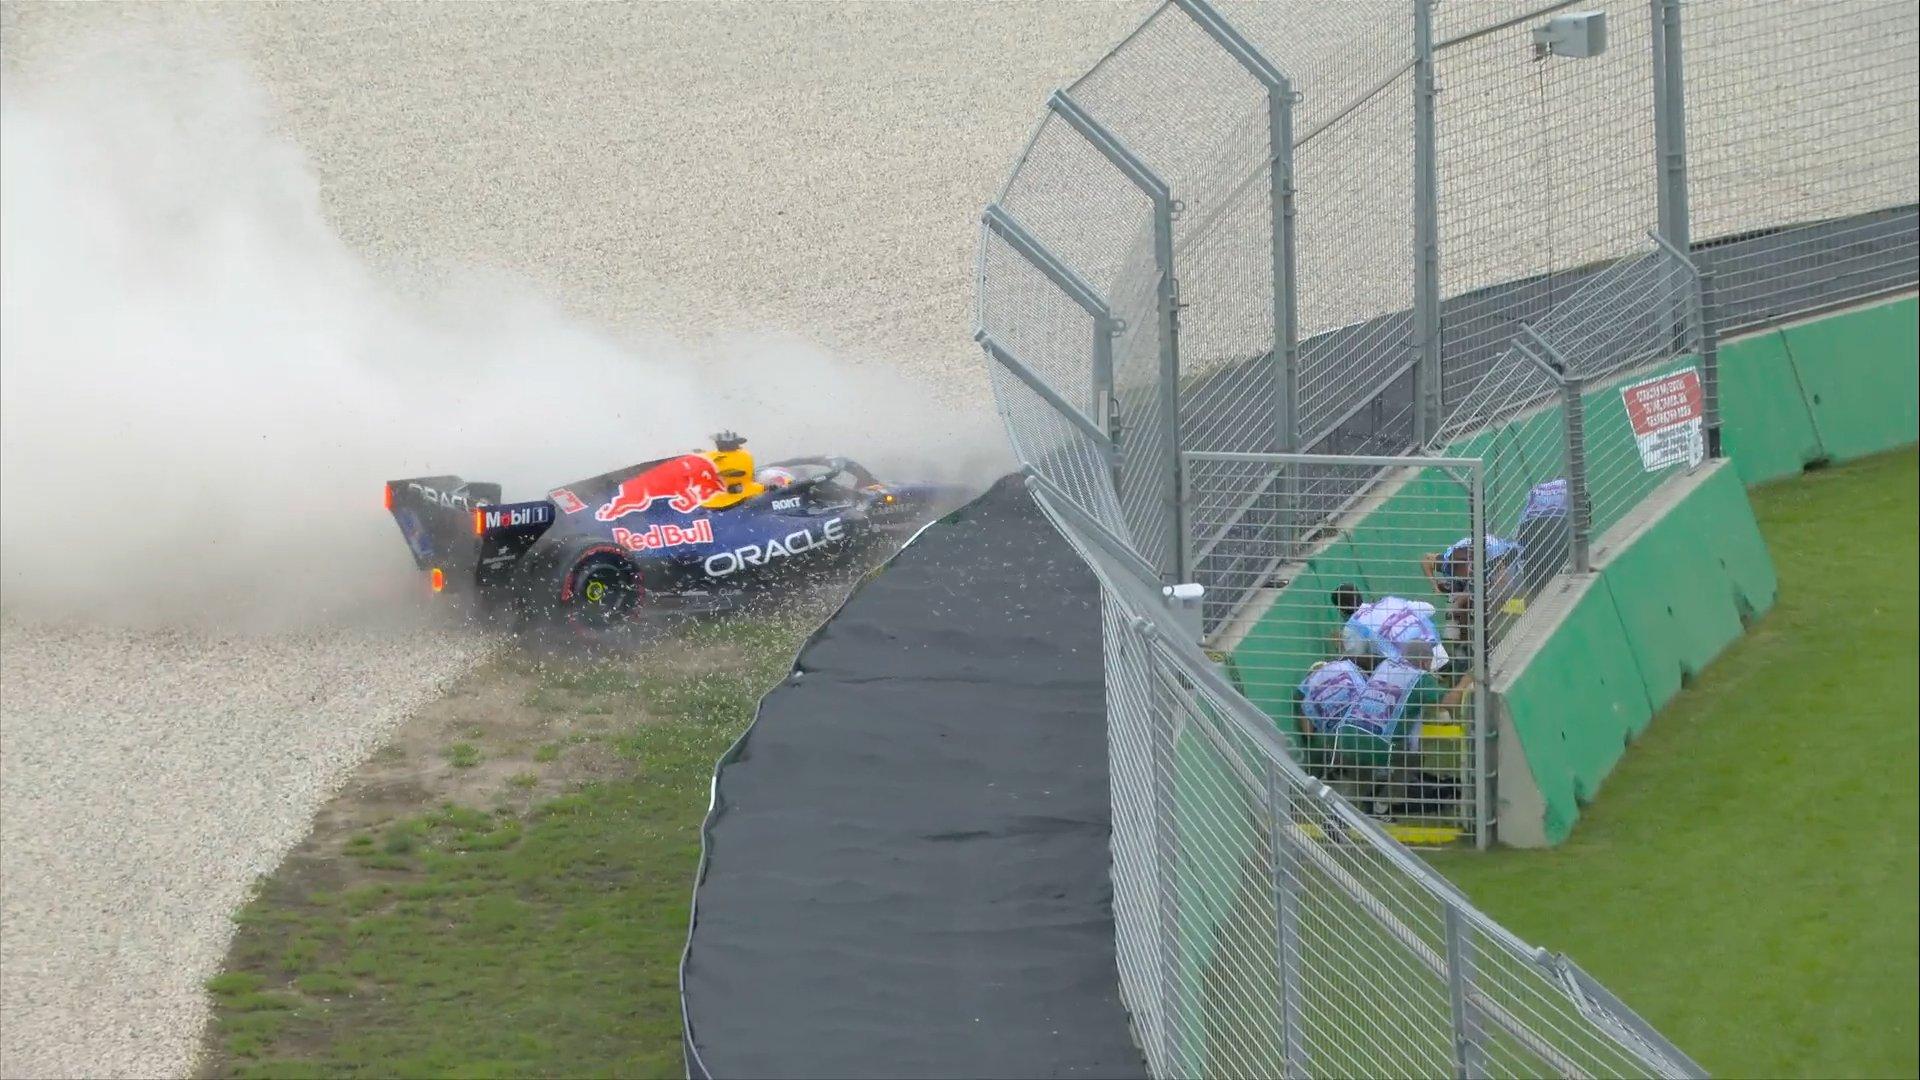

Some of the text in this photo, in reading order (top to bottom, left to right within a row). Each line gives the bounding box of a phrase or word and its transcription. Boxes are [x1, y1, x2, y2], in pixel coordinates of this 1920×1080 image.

[486, 507, 546, 528] Mobil 1
[612, 519, 714, 550] Red Bull
[704, 517, 845, 577] ORACLE
